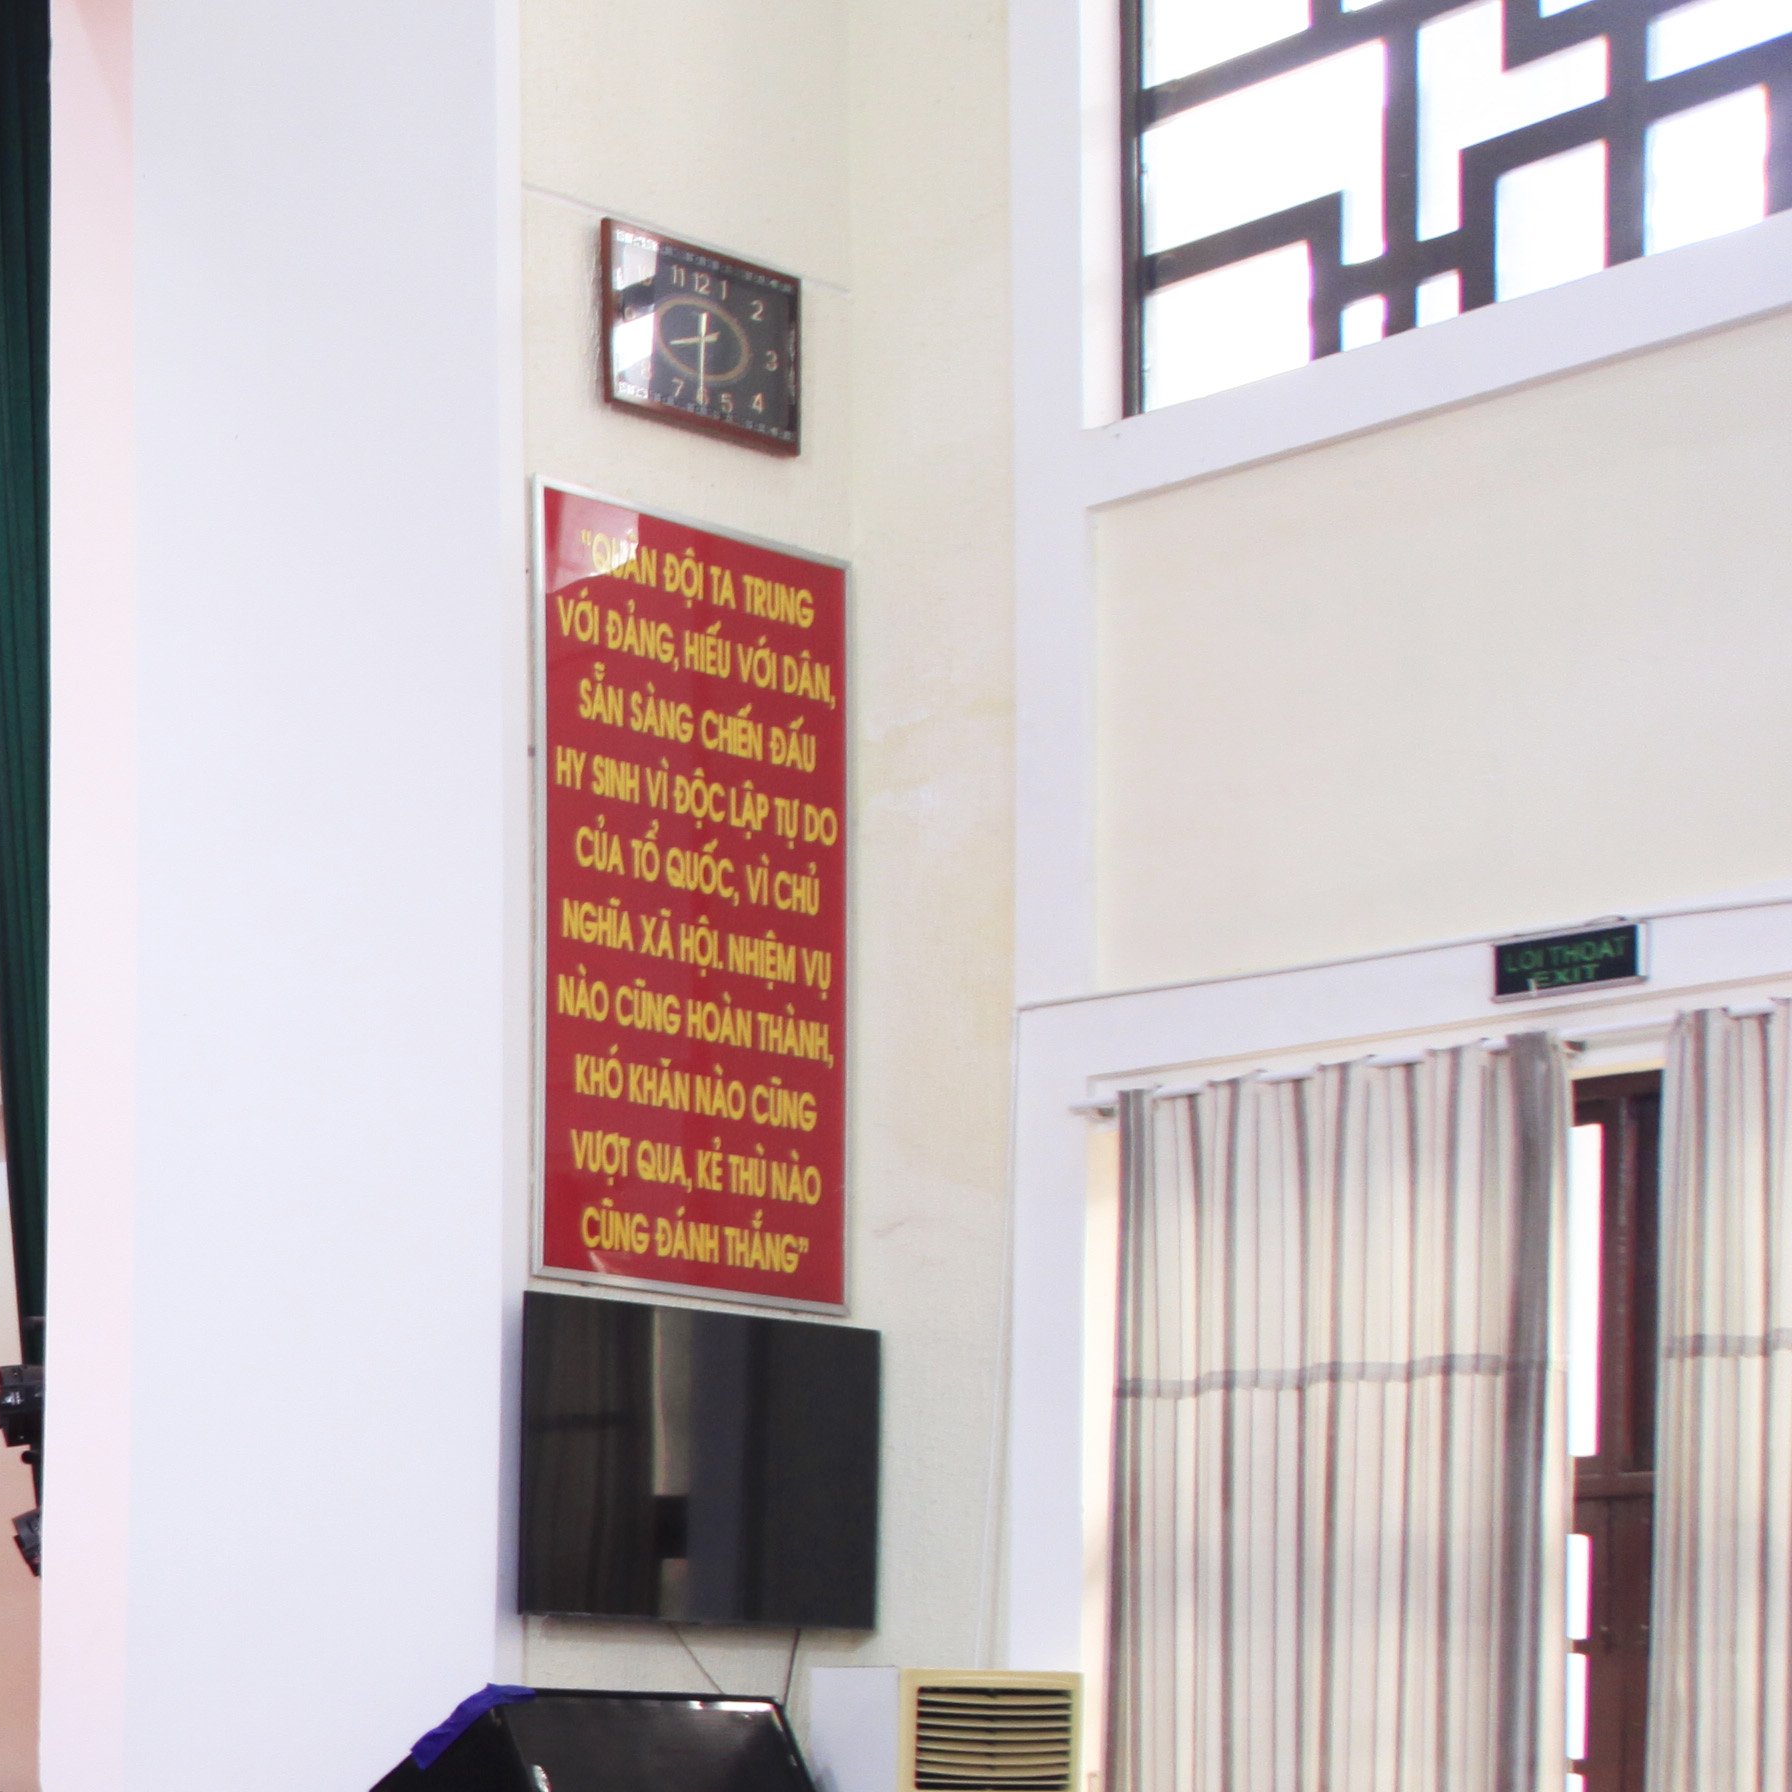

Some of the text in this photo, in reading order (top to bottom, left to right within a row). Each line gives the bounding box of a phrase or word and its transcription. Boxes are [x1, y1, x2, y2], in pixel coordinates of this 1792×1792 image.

[671, 264, 686, 287] 11
[692, 271, 710, 295] 12
[720, 279, 728, 300] 1
[750, 300, 765, 322] 2
[672, 378, 685, 398] 7
[765, 350, 778, 372] 3
[720, 392, 733, 414] 5
[751, 392, 765, 415] 4
[663, 546, 704, 608] ĐỘI
[710, 565, 736, 610] TA
[742, 574, 815, 628] TRUNG
[557, 587, 836, 710] VỚI ĐẢNG, HIẾU VỚI DÂN,
[579, 662, 817, 773] SẴN SÀNG CHIẾN ĐẤU
[555, 745, 838, 848] HY SINH VÌ ĐỘC LẬP TỰ DO
[575, 814, 820, 915] CỦA TỔ QUỐC, VÌ CHỦ
[562, 897, 832, 1000] NGHĨA XÃ HỘI. NHIỆM VỤ
[1531, 963, 1600, 988] EXIT
[558, 963, 834, 1069] NÀO CŨNG HOÀN THÀNH,
[574, 1043, 817, 1132] KHÓ KHĂN NÀO CŨNG
[571, 1128, 821, 1205] VƯỢT QUA, KẺ THÙ NÀO
[581, 1197, 650, 1255] CŨNG
[655, 1207, 719, 1265] ĐÁNH
